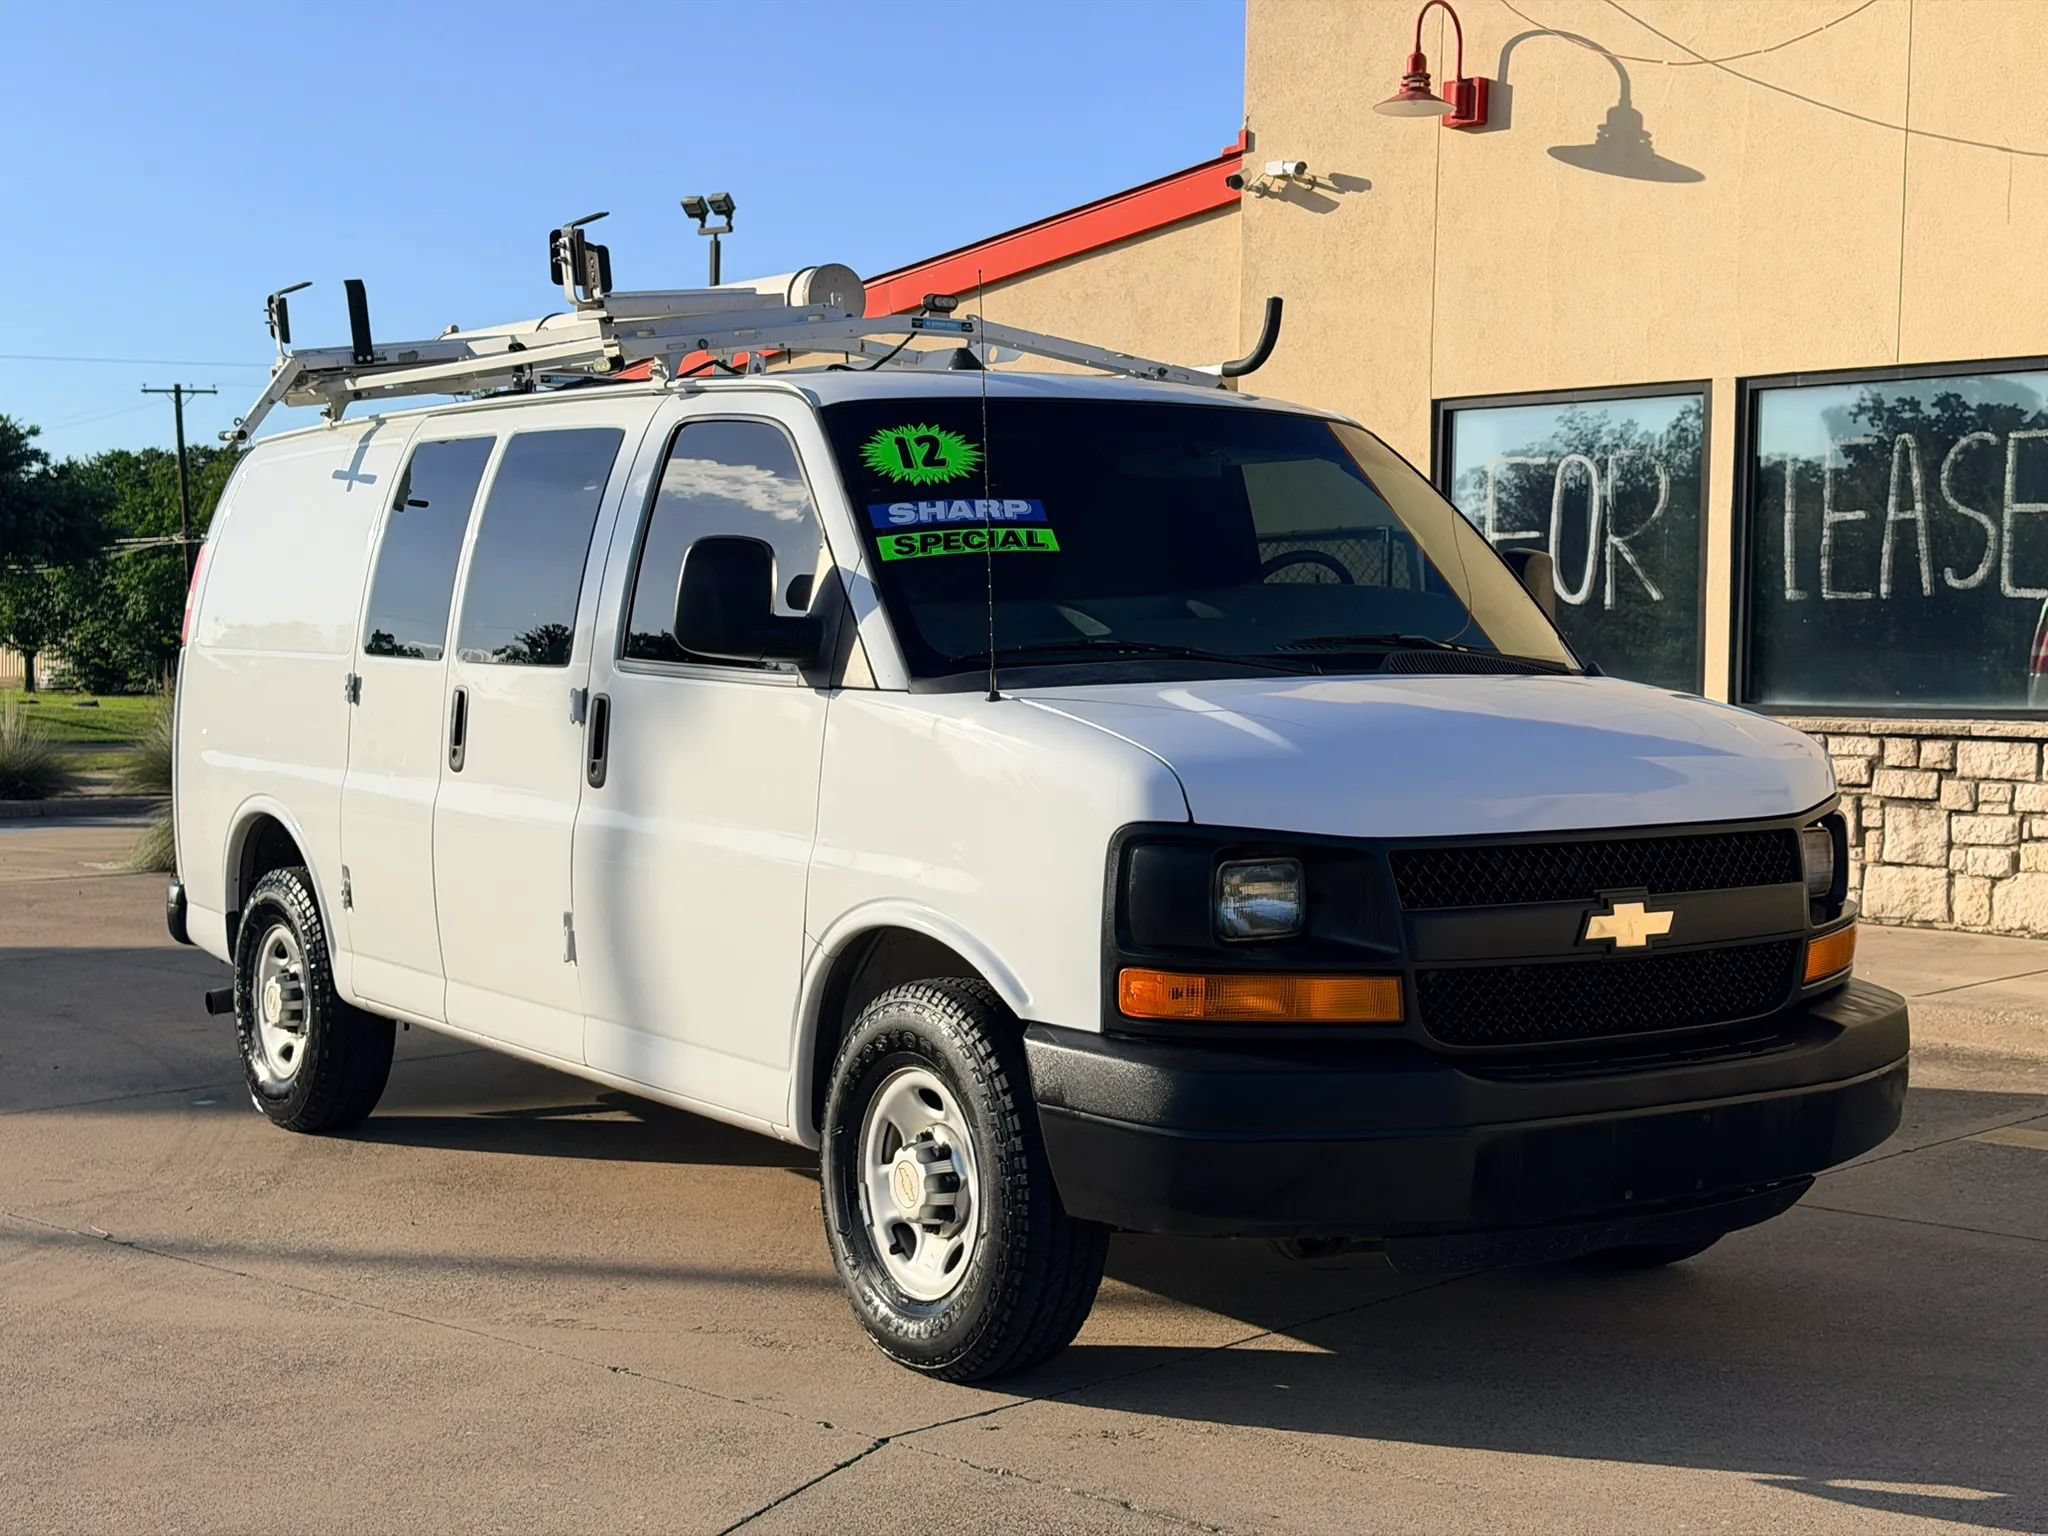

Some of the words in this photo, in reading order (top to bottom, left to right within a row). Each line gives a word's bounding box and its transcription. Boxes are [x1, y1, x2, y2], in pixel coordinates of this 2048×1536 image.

[893, 434, 949, 470] 12
[888, 499, 1032, 526] SHARP
[1484, 451, 1671, 610] FOR
[1782, 430, 2048, 601] LEASE
[893, 530, 1050, 558] SPECIAL
